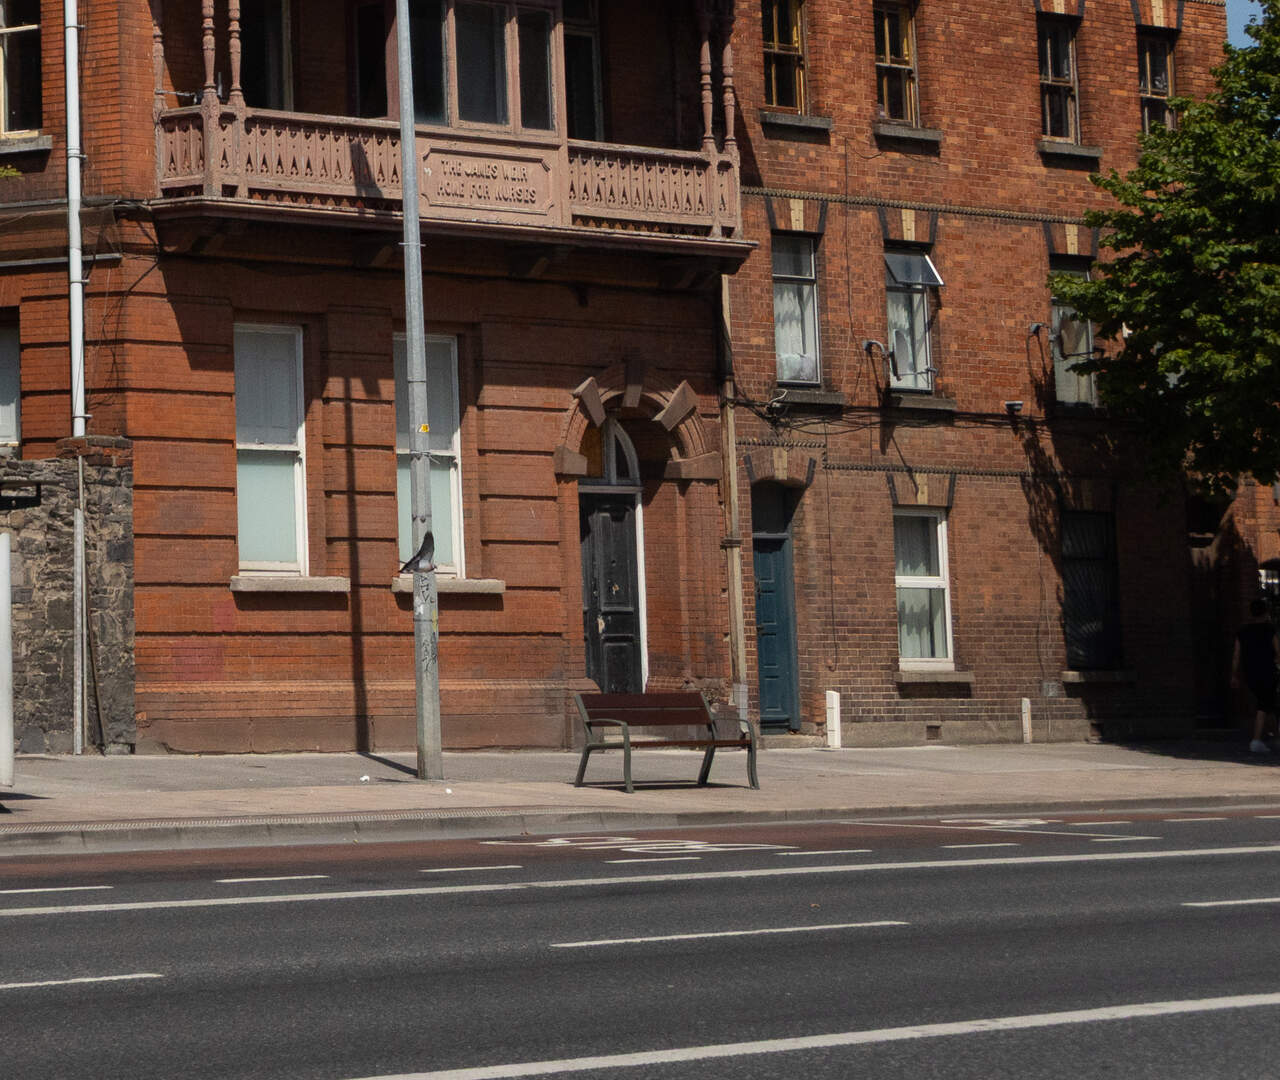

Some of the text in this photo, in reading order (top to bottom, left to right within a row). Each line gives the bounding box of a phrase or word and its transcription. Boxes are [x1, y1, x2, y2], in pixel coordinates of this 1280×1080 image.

[441, 160, 528, 182] THE JAMES WEIR
[437, 181, 537, 204] HOME FOR NURSES
